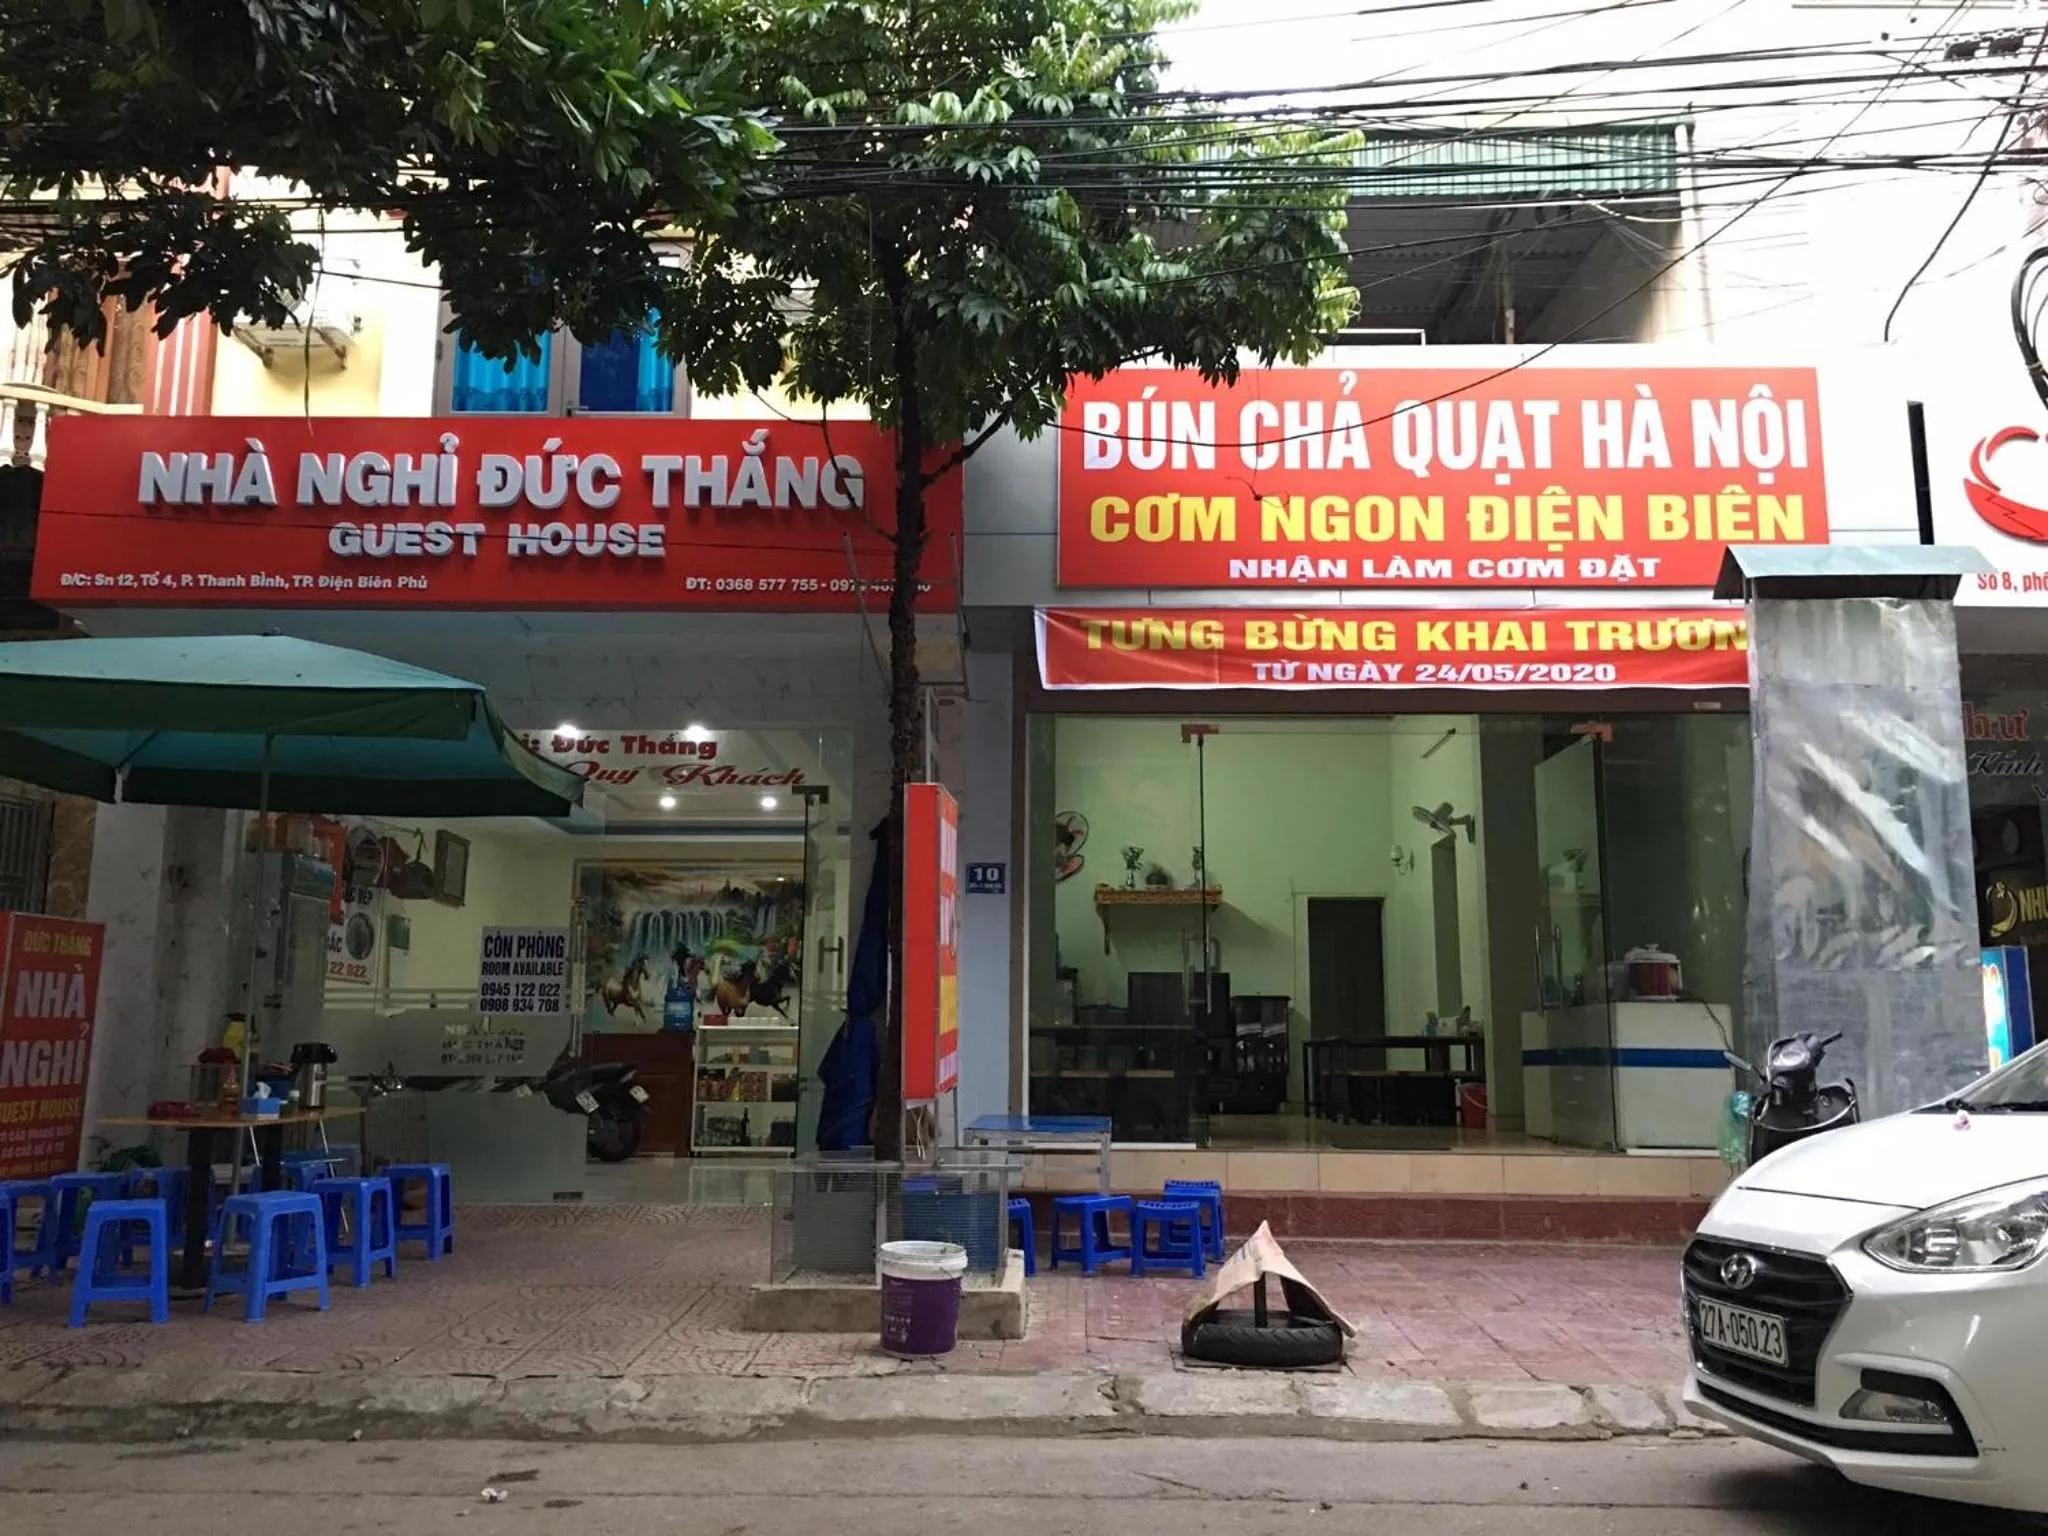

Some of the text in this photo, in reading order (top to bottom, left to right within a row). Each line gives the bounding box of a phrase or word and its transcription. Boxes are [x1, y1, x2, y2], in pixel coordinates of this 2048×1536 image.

[1083, 371, 1809, 485] BÚN CHẢ QUẠT HÀ NỘI
[138, 428, 865, 509] NHÀ NGHỈ ĐỨC THẮNG
[1090, 484, 1805, 552] CƠM NGON ĐIỆN BIÊN
[329, 522, 666, 558] GUEST HOUSE
[94, 574, 115, 587] Sn
[197, 574, 247, 587] Thanh
[318, 575, 354, 592] Điện
[357, 575, 393, 589] Biên
[1229, 554, 1662, 583] NHẬN LÀM CƠM ĐẶT
[685, 577, 712, 591] ĐT:
[716, 578, 754, 592] 0368
[759, 579, 785, 592] 577
[1083, 617, 1225, 650] TƯNG
[1244, 614, 1397, 651] BỪNG
[1417, 621, 1547, 651] KHAI
[1252, 659, 1616, 683] TỪ NGÀY 24/05/2020
[552, 733, 610, 754] Đức
[620, 731, 718, 760] Thắng
[661, 763, 807, 787] Khách
[973, 867, 999, 882] 10
[484, 931, 565, 958] CÒN PHÒNG
[481, 962, 564, 976] ROOM AVAILABLE
[14, 963, 86, 1018] NHÀ
[481, 983, 561, 997] 0945 122 022
[0, 1022, 90, 1088] NGHỈ
